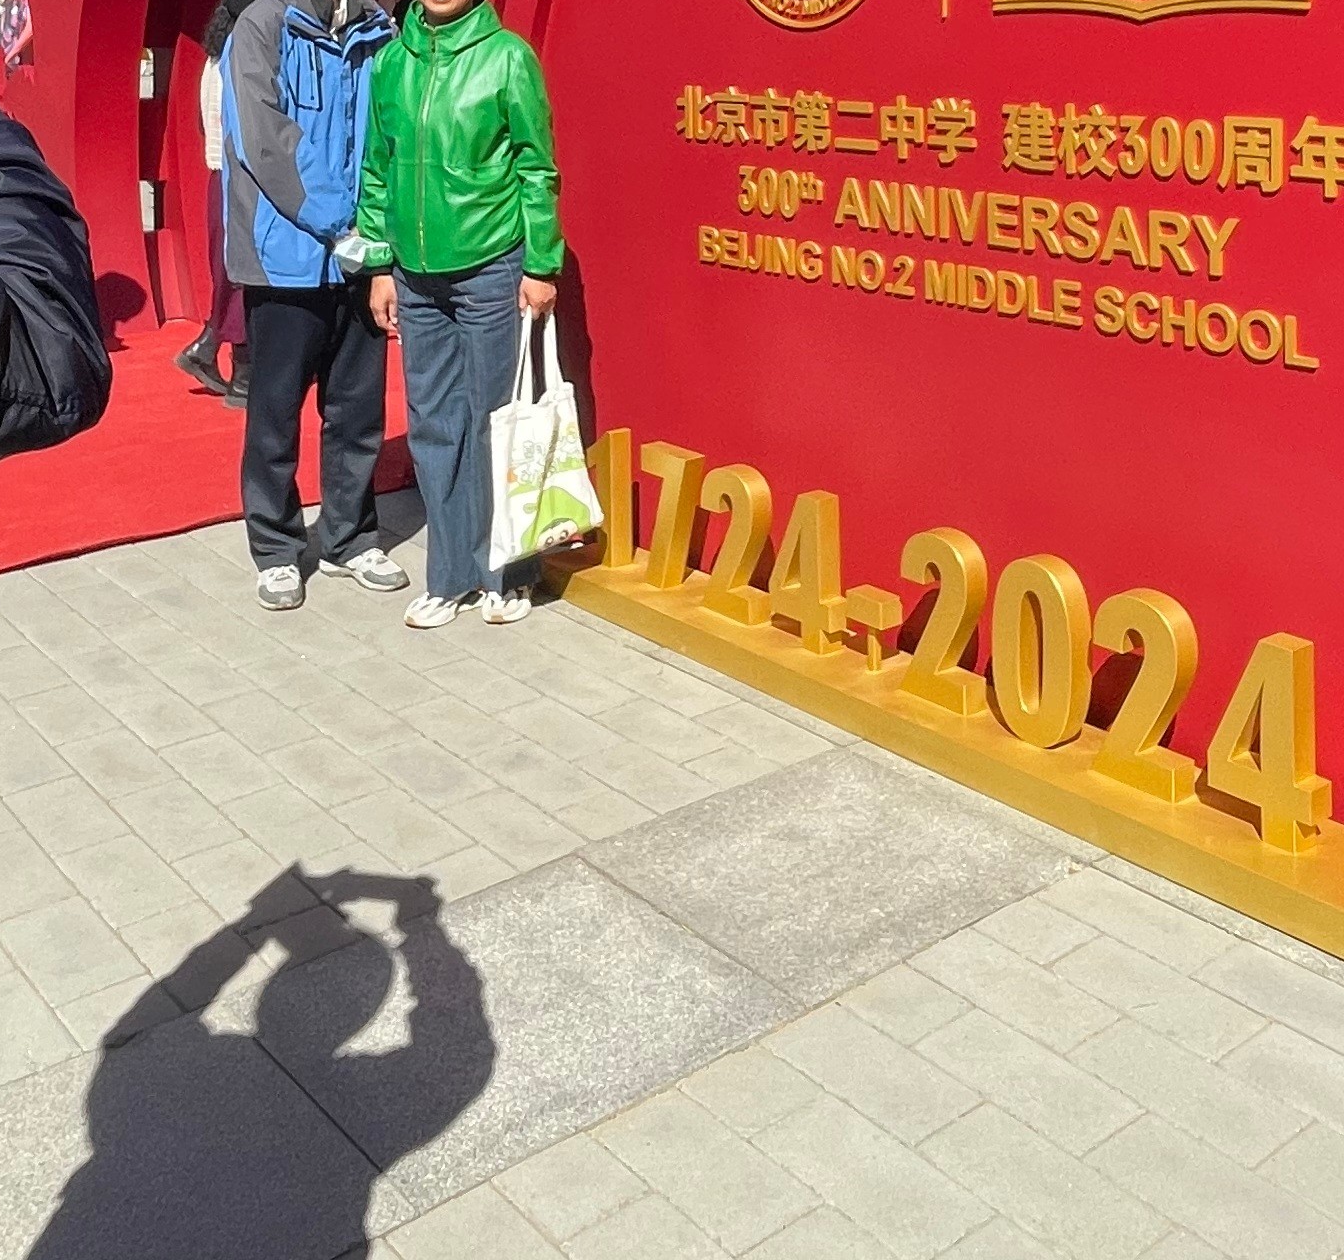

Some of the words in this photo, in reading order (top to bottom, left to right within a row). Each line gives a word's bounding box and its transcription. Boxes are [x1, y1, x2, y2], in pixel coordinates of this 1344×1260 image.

[675, 84, 978, 165] 北京市第二中学
[737, 164, 825, 220] 300th
[834, 177, 1241, 279] ANNIVERSARY
[698, 225, 823, 281] BEIJING
[830, 244, 916, 298] NO.2
[923, 259, 1084, 329] MIDDLE
[1093, 285, 1321, 371] SCHOOL
[588, 426, 1332, 856] 1724-2024
